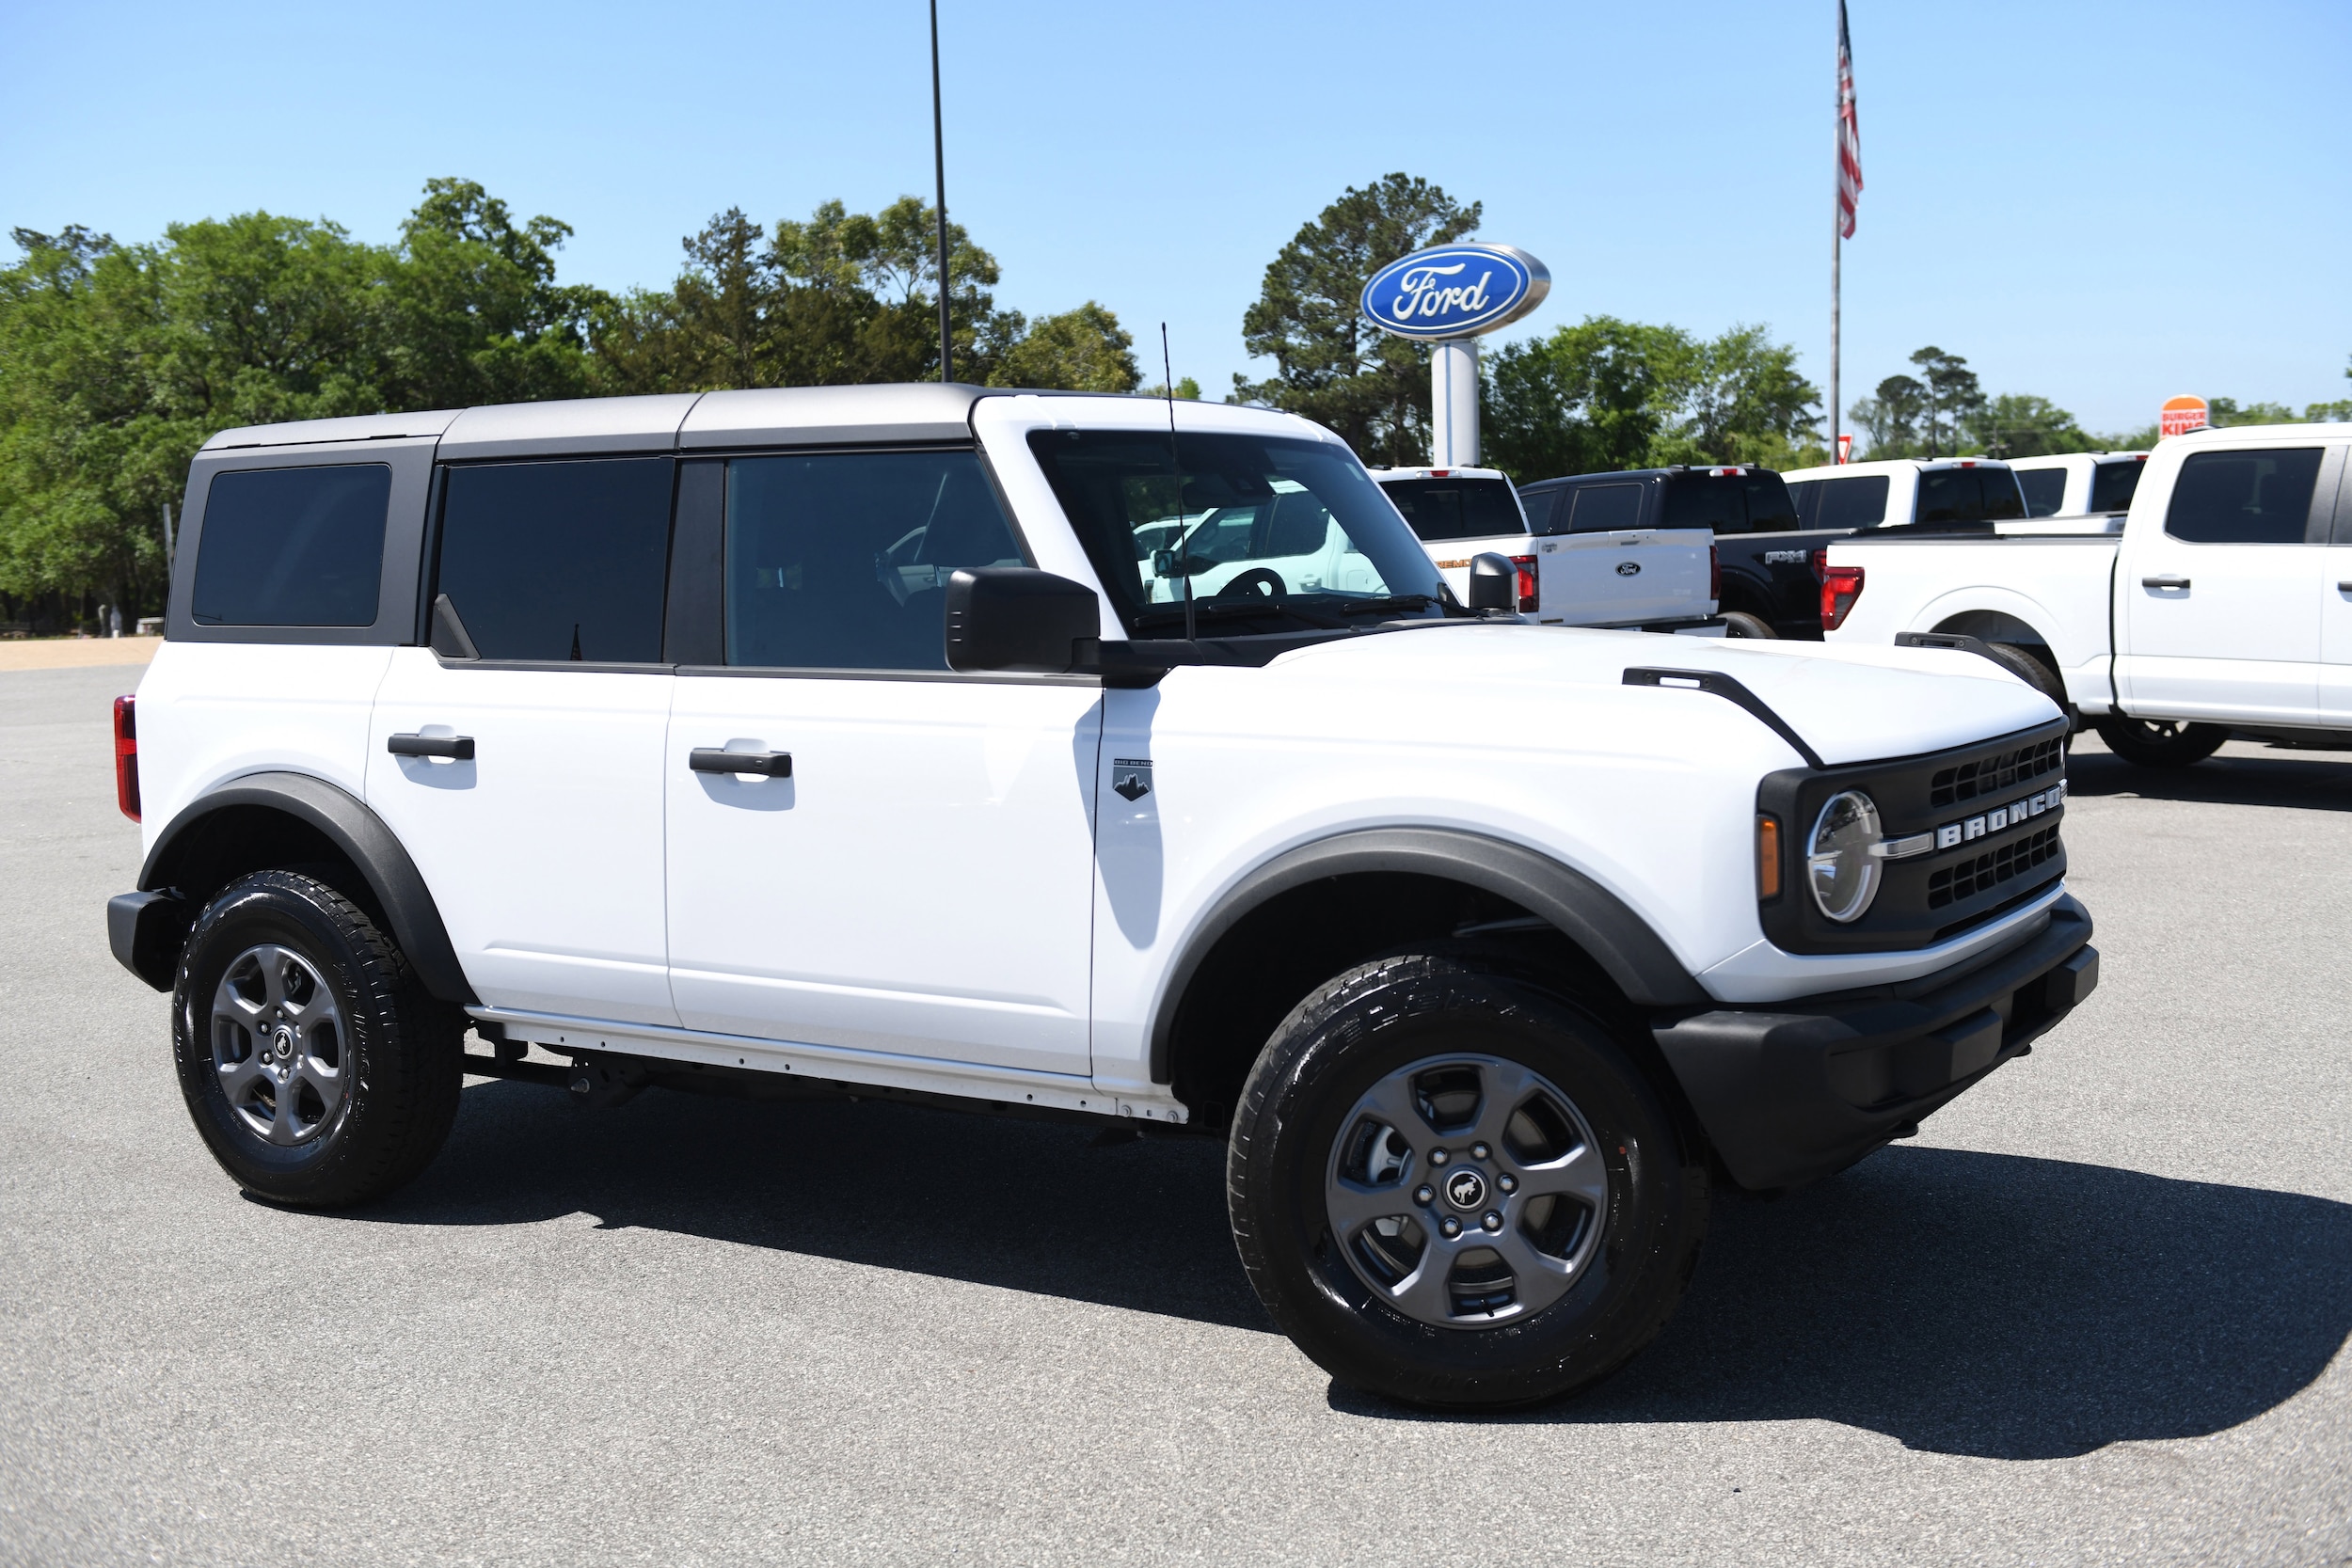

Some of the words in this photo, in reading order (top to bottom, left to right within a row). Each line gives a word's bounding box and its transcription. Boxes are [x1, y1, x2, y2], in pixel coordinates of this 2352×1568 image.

[1392, 262, 1493, 321] Ford
[2162, 411, 2206, 421] BURGER
[1765, 549, 1807, 564] FX4
[1937, 786, 2061, 849] BRONCO
